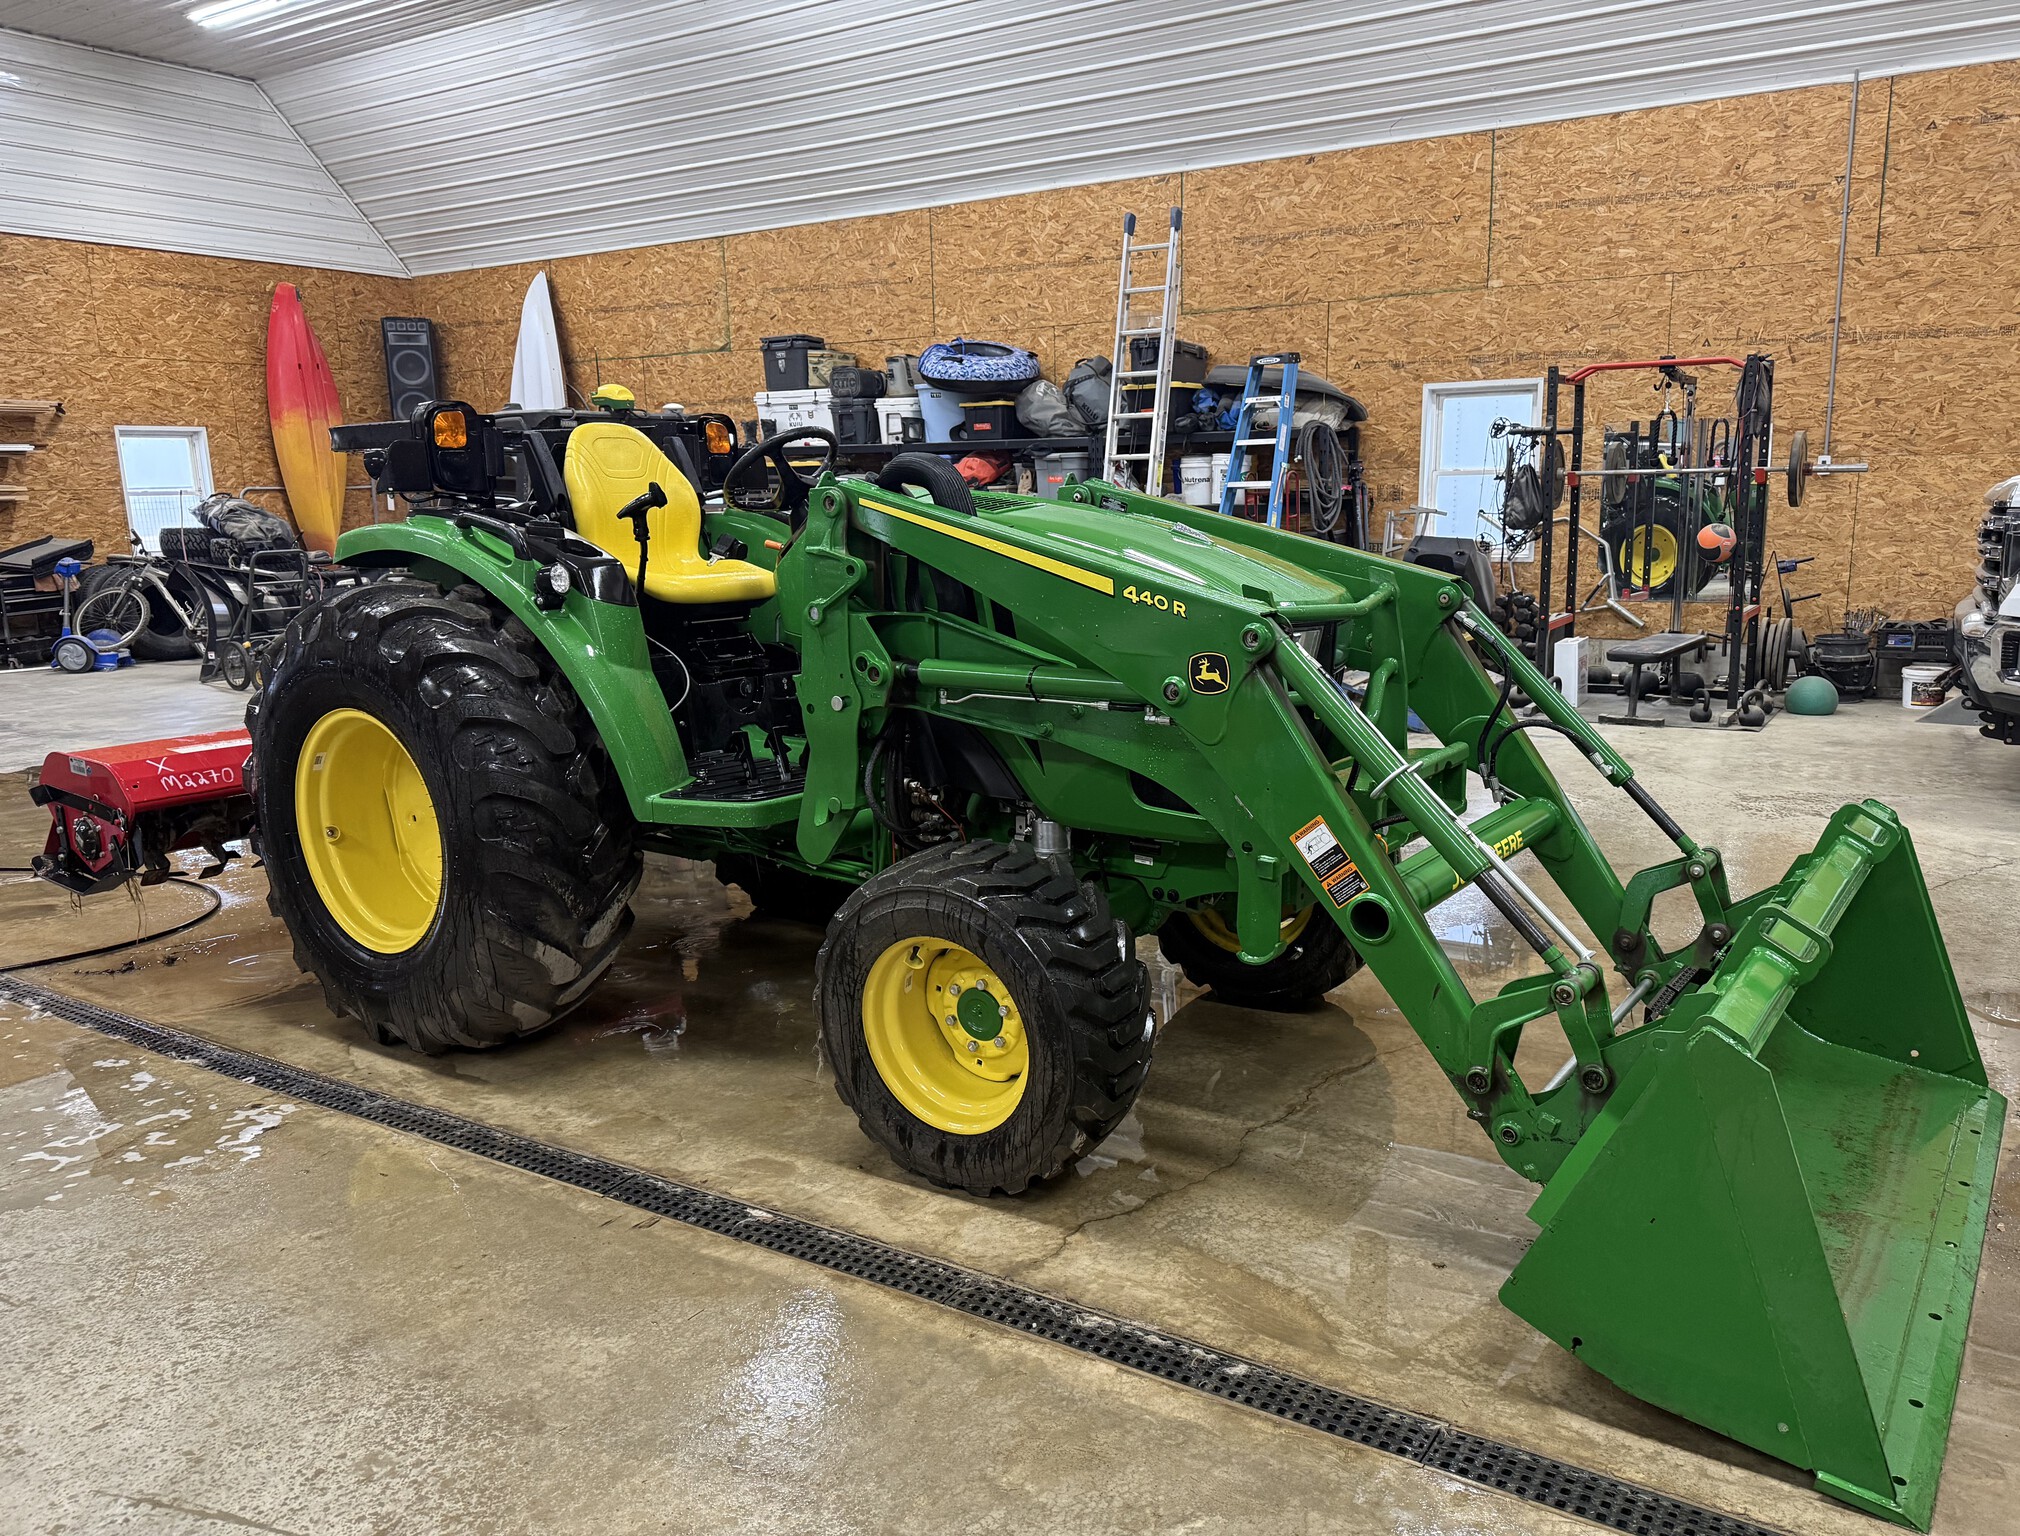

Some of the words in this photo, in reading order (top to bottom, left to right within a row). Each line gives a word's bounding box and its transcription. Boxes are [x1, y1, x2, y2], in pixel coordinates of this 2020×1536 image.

[1081, 402, 1099, 420] KUIU
[1122, 585, 1169, 611] 440
[146, 757, 174, 774] X
[160, 767, 234, 791] M2270
[1299, 819, 1320, 837] WARNING
[1331, 866, 1353, 882] WARNING
